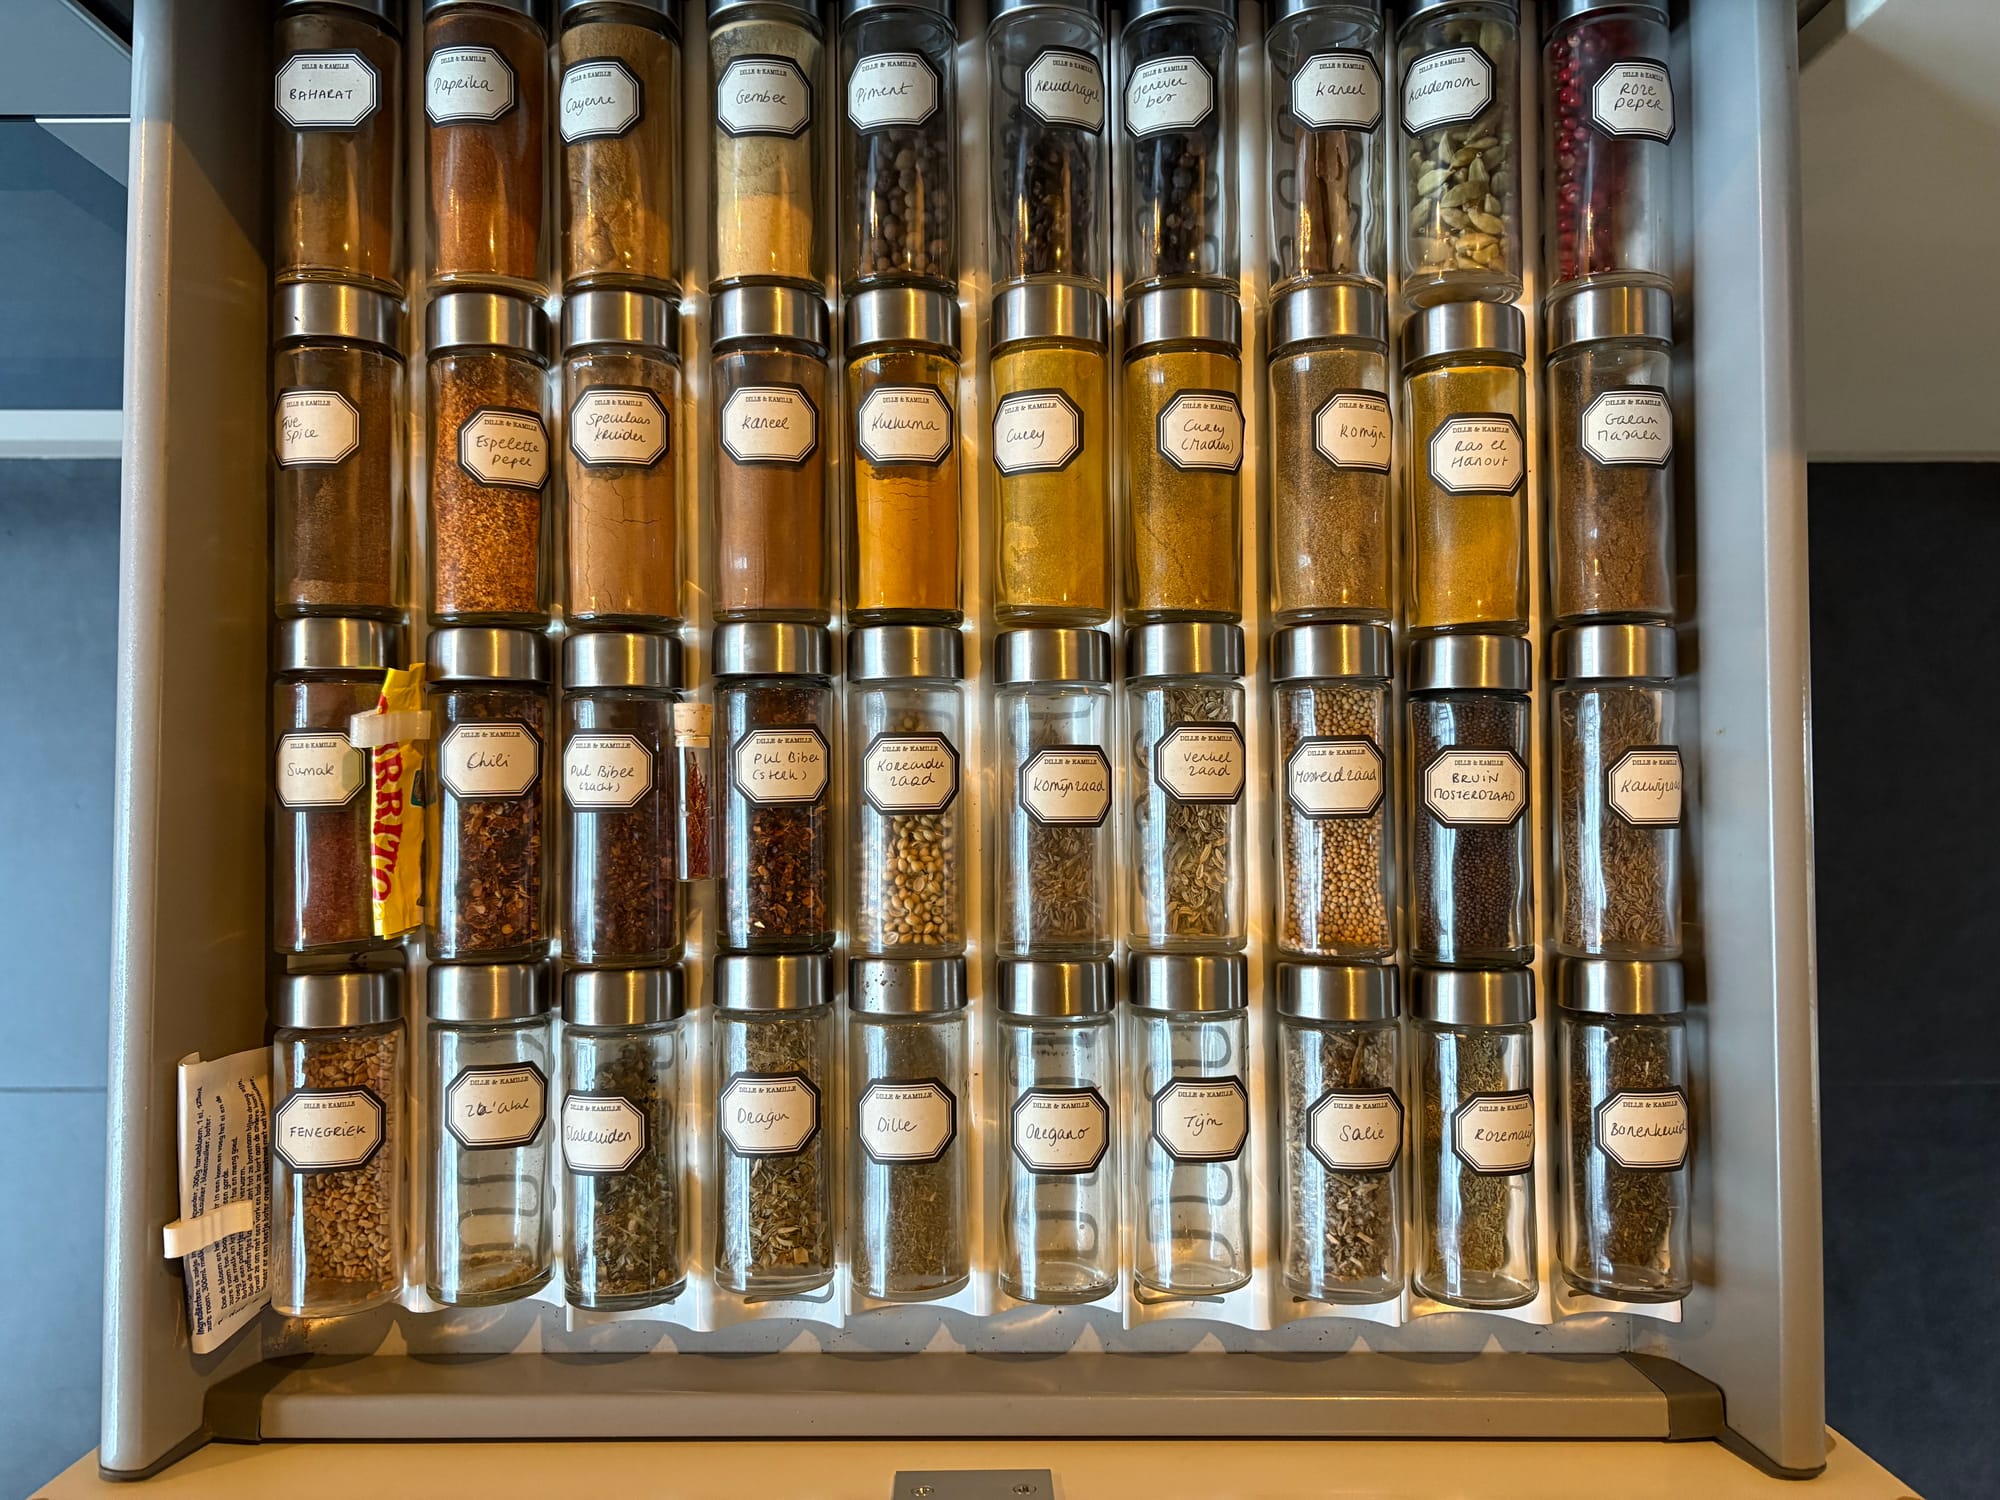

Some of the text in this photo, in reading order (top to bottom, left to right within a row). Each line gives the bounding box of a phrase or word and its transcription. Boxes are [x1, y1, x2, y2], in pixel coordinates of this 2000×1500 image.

[433, 75, 494, 95] Paprika
[856, 82, 913, 104] Piment
[289, 87, 354, 101] BAHARAT
[735, 88, 788, 106] Gember
[565, 94, 616, 116] Cayenne
[1614, 96, 1664, 111] peper
[586, 411, 651, 427] Speculaas
[871, 413, 940, 432] Kurkuma
[1605, 413, 1658, 425] Garam
[1006, 426, 1046, 449] Curry
[1183, 419, 1225, 440] Curry
[1597, 429, 1662, 441] Masala
[476, 435, 540, 454] Espelette
[1181, 437, 1234, 453] (Madras)
[1455, 439, 1508, 451] Ras el
[491, 453, 532, 466] peper
[1451, 455, 1510, 468] Hanout
[466, 752, 512, 770] Chili
[753, 752, 821, 766] Pul Biber
[287, 762, 335, 778] Sumak
[570, 764, 635, 778] Pul Biber
[1189, 764, 1231, 777] zaad
[890, 773, 936, 786] zaad
[1434, 787, 1516, 801] MOSTERDZAAD
[289, 1121, 366, 1138] FENEGRIEK
[877, 1117, 918, 1133] Dille
[1339, 1123, 1385, 1141] Salie
[1026, 1124, 1091, 1147] Oregano
